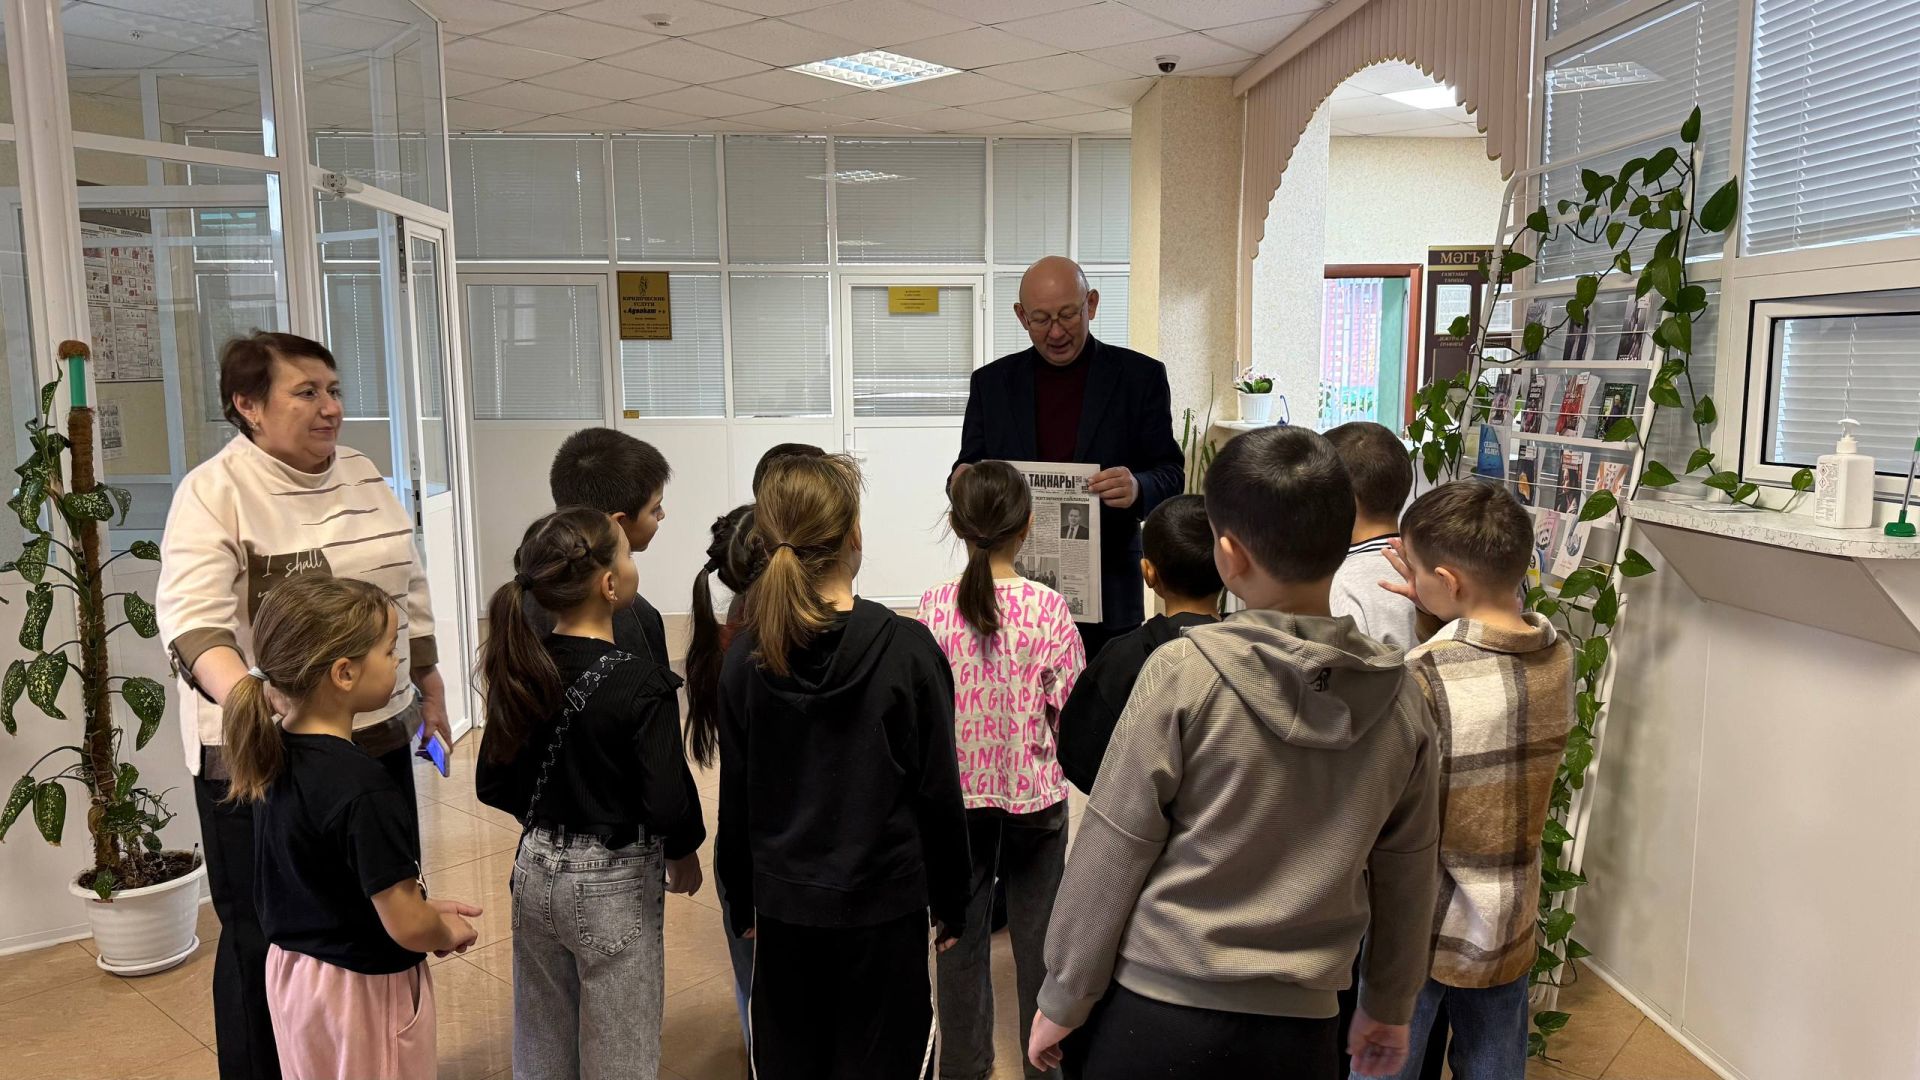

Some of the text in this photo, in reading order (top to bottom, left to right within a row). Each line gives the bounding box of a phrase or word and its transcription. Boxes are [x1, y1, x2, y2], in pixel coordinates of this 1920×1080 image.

[1028, 474, 1075, 489] ТАҢНАРЫ
[284, 549, 323, 578] shall
[933, 607, 967, 630] PIN
[967, 631, 1012, 657] GIRL
[960, 658, 1007, 686] GIRL
[961, 715, 1007, 743] GIRL
